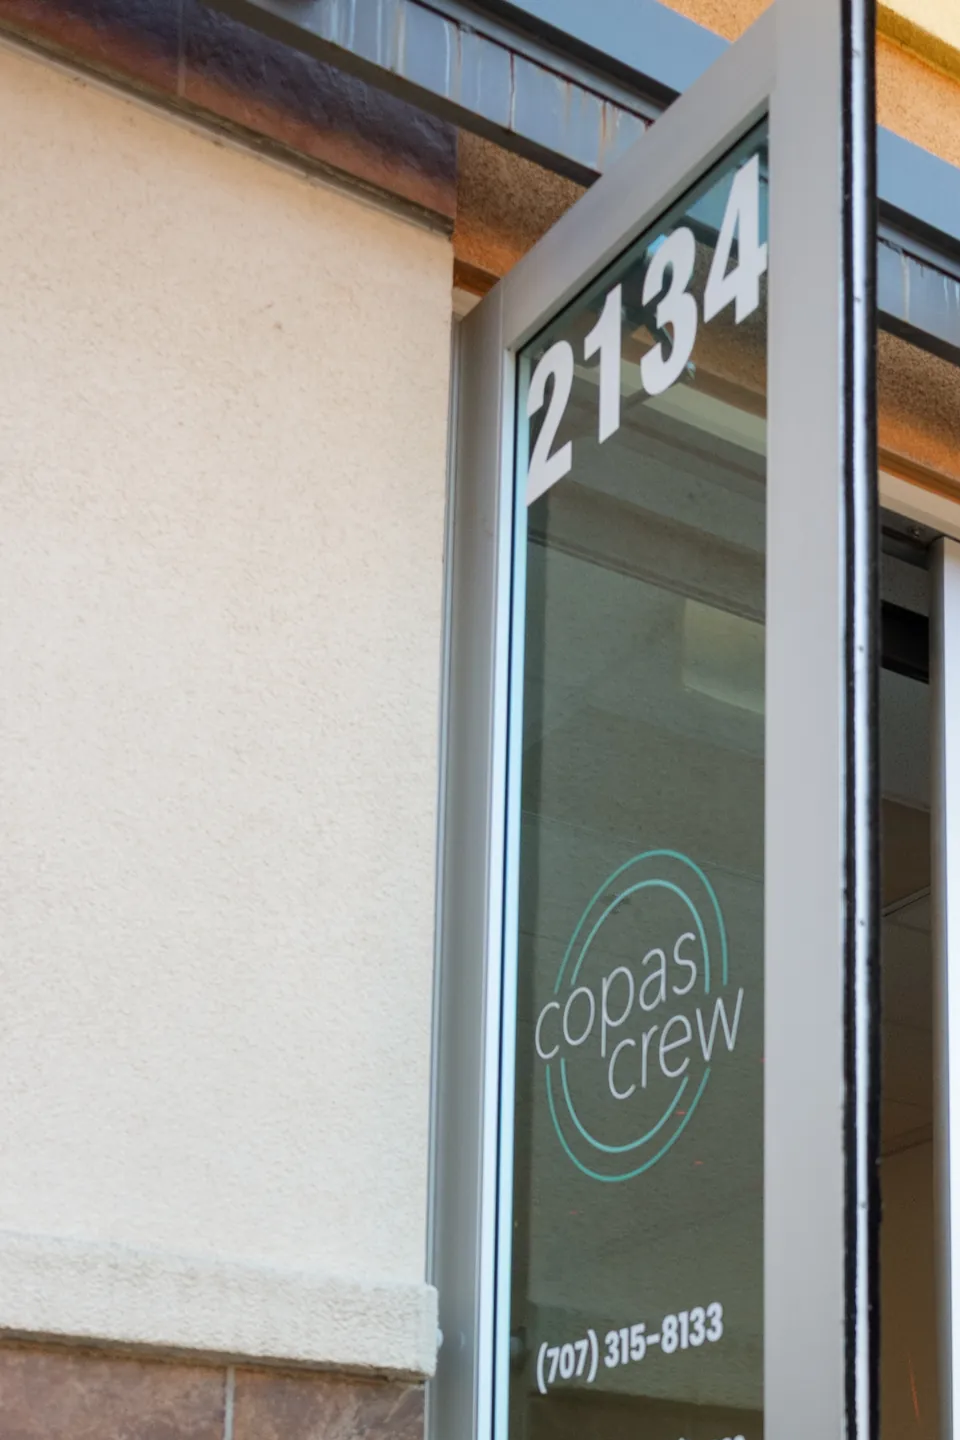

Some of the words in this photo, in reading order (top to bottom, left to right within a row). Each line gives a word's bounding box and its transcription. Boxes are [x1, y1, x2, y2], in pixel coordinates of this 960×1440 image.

[526, 153, 768, 507] 2134
[535, 931, 697, 1060] copas
[607, 986, 745, 1100] crew
[536, 1328, 599, 1395] (707)
[603, 1301, 725, 1369] 315-8133
